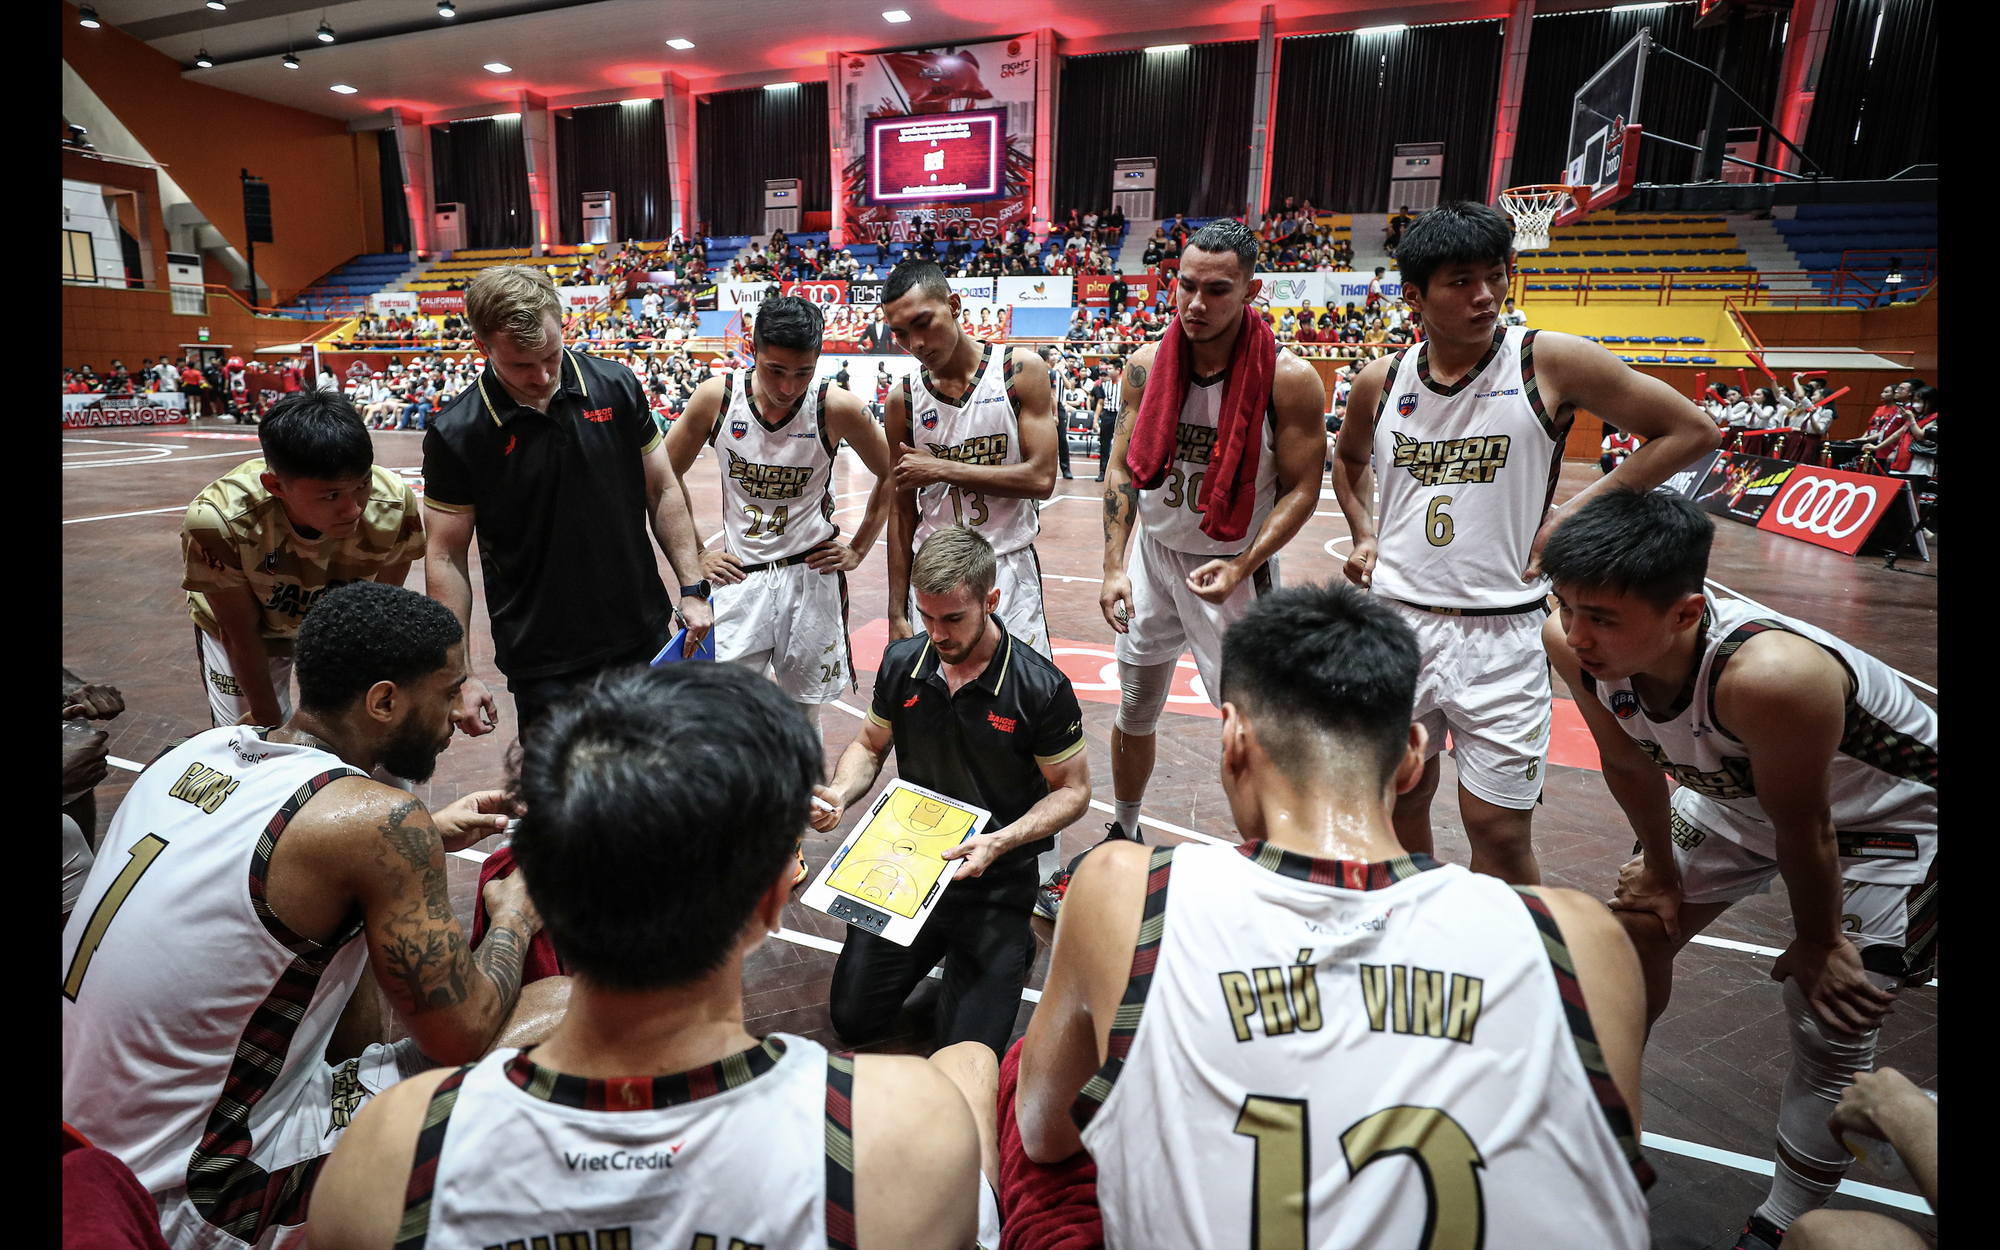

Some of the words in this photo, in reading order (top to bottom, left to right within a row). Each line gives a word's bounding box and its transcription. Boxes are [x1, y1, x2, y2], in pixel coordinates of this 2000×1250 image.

[1000, 70, 1015, 78] ON
[1001, 60, 1030, 70] FIGHT
[939, 207, 971, 219] LONG
[1087, 280, 1110, 295] play
[1341, 283, 1368, 296] THAN
[420, 297, 463, 305] CALIFORNIA
[66, 407, 182, 427] WARRIORS
[733, 421, 747, 430] VBA
[922, 410, 936, 421] VBA
[1393, 434, 1511, 468] SAIGON
[729, 460, 813, 487] SAIGON
[1420, 460, 1505, 487] HEAT
[747, 480, 807, 500] HEAT
[948, 486, 989, 528] 13
[743, 504, 789, 539] 24
[1425, 495, 1455, 547] 6
[820, 660, 842, 683] 24
[1526, 756, 1541, 781] 6
[62, 831, 170, 1004] 1
[1219, 947, 1323, 1043] PHÚ
[1360, 963, 1484, 1044] VINH
[564, 1150, 674, 1172] VietCredit
